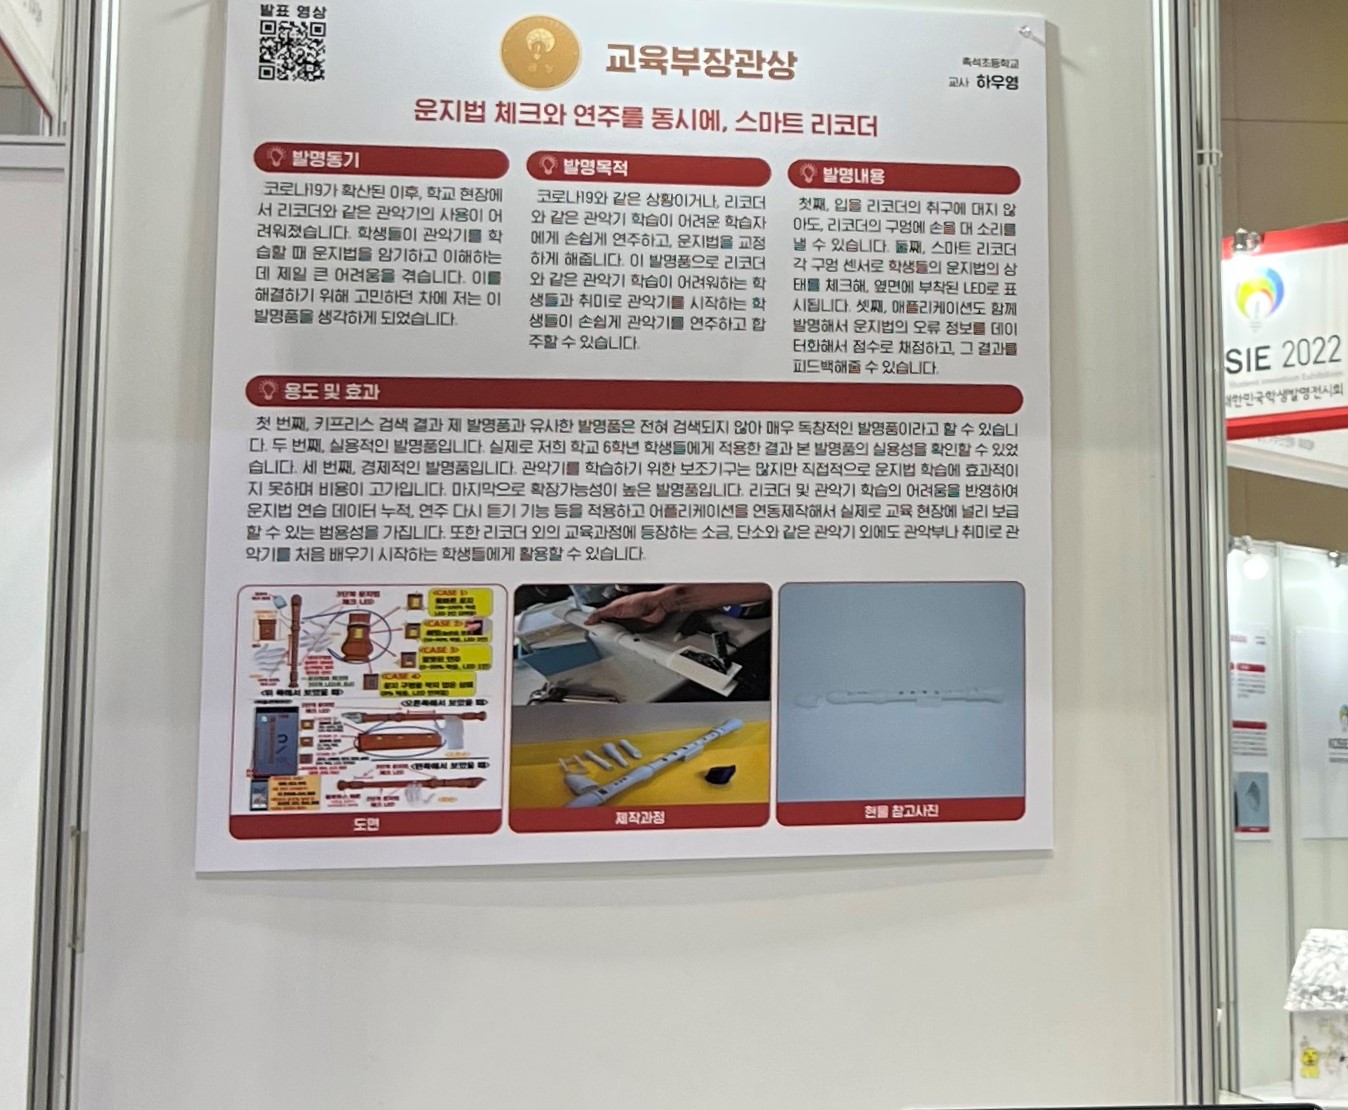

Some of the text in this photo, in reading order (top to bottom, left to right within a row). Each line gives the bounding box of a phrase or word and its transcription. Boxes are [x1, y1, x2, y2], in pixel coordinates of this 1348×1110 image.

[260, 3, 327, 20] 발표 영상
[605, 43, 799, 80] 교육부장관상
[948, 74, 1019, 90] 교사 하우영
[413, 98, 878, 138] 운지법 체크와 연주를 동시에, 스마트 리코더
[292, 150, 360, 168] 발명동기
[563, 158, 628, 176] 발명목적
[823, 167, 885, 185] 발명내용
[263, 181, 503, 203] 코로나19가 확산된 이후, 학교 현장에
[536, 189, 766, 210] 코로나19와 같은 상황이거나, 리코더
[257, 202, 503, 223] 서 리코더와 같은 관악기의 사용이 어
[798, 197, 1017, 218] 첫째, 입을 리코더의 취구에 대지 않
[256, 223, 504, 244] 려워졌습니다. 학생들이 관악기를 학
[1282, 334, 1342, 368] 2022
[284, 383, 381, 400] 용도 및 효과
[256, 415, 1019, 437] 첫 번째, 키프리스 검색 결과 제 발명품과 유사한 발명품은 전혀 검색되지 않아 매우 독창적인 발명품이라고 할 수 있습니
[353, 818, 380, 831] 도면
[615, 810, 665, 825] 제작과정
